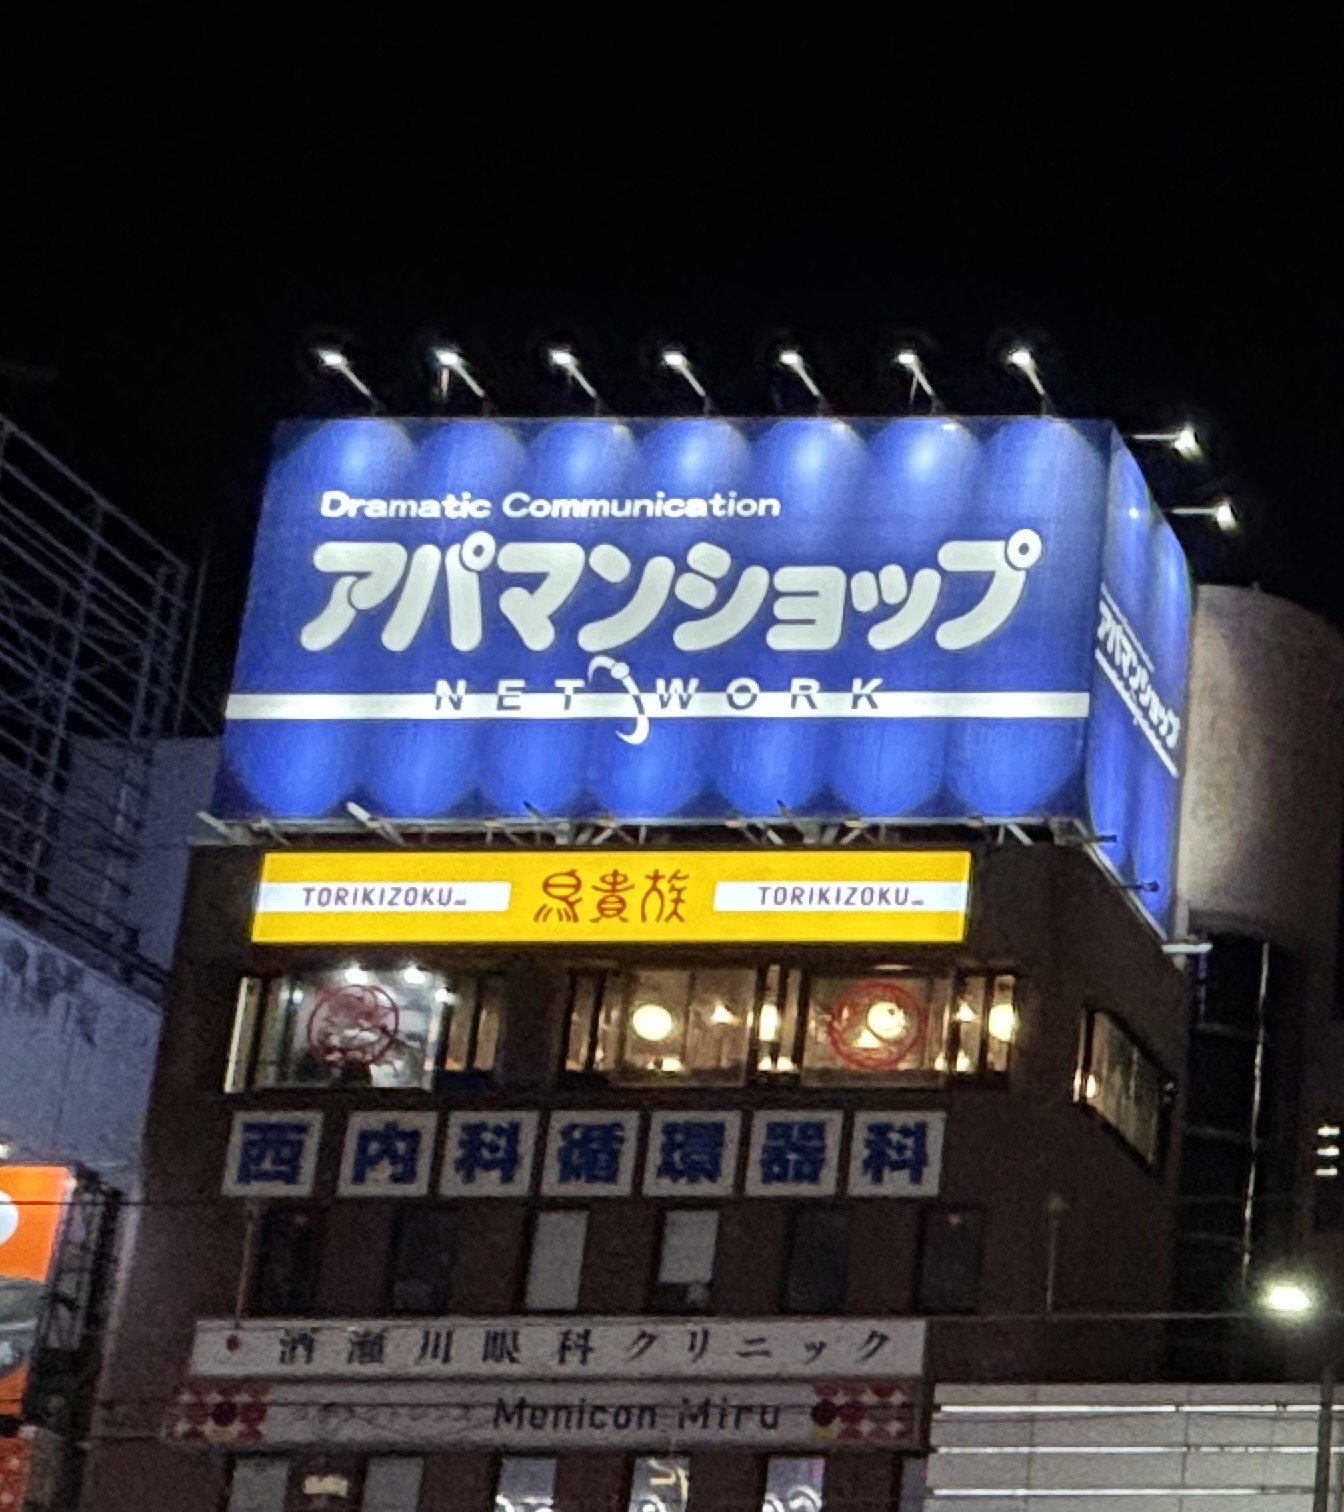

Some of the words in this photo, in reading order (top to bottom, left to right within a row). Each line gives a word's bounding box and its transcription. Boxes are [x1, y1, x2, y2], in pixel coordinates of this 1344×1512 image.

[319, 491, 493, 520] Dramatic
[501, 491, 782, 520] Communication
[298, 528, 1044, 653] アパマンショップ
[302, 884, 456, 908] TORIKIZOKU
[756, 884, 910, 908] TORIKIZOKU
[492, 1396, 657, 1431] Menicon
[677, 1395, 780, 1431] Miru
